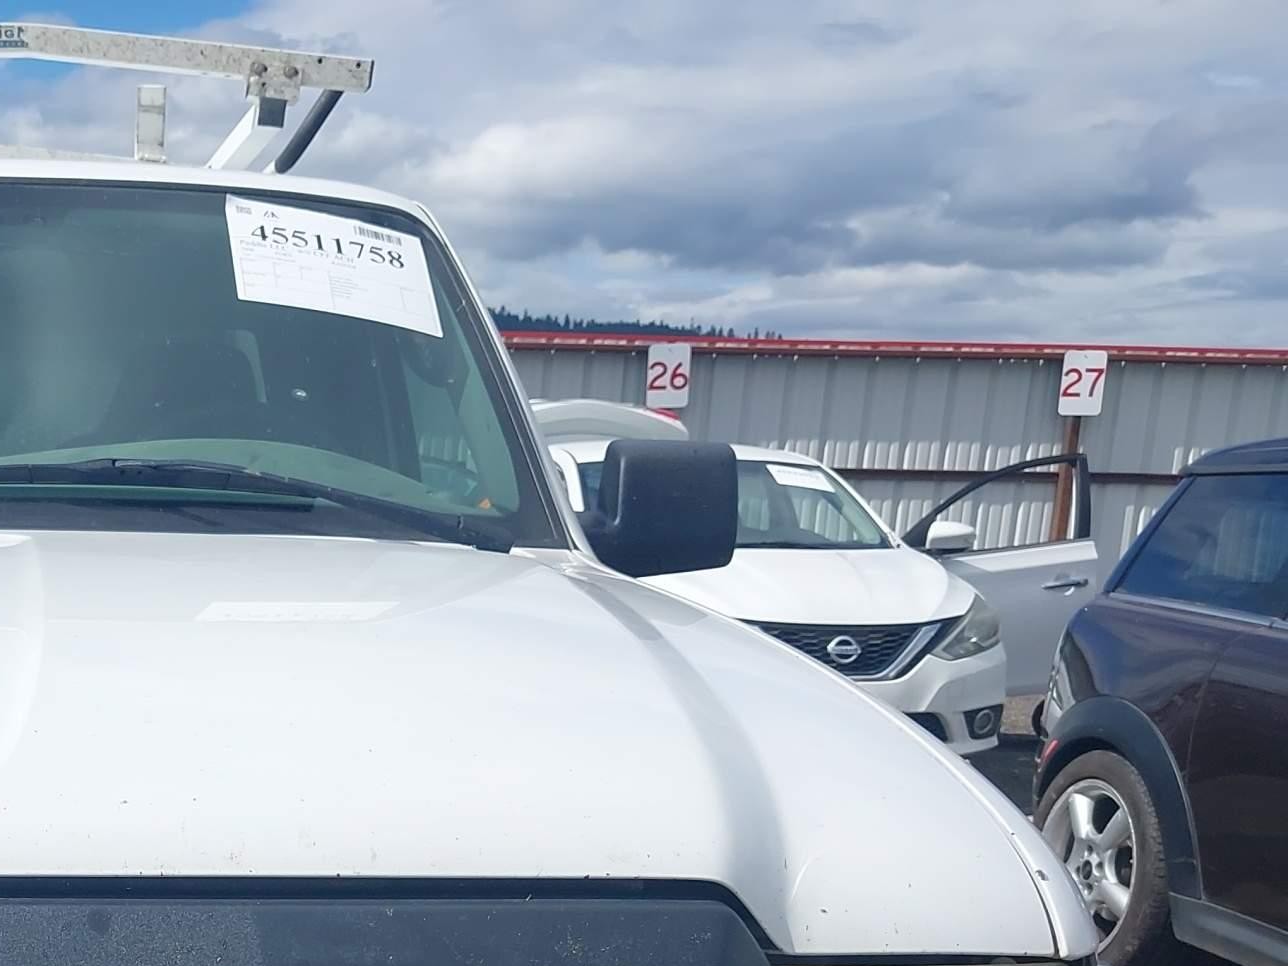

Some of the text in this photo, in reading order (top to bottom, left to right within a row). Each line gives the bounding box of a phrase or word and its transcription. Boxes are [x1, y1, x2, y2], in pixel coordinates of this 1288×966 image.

[251, 225, 405, 270] 45511758
[648, 361, 688, 391] 26
[1061, 367, 1105, 398] 27
